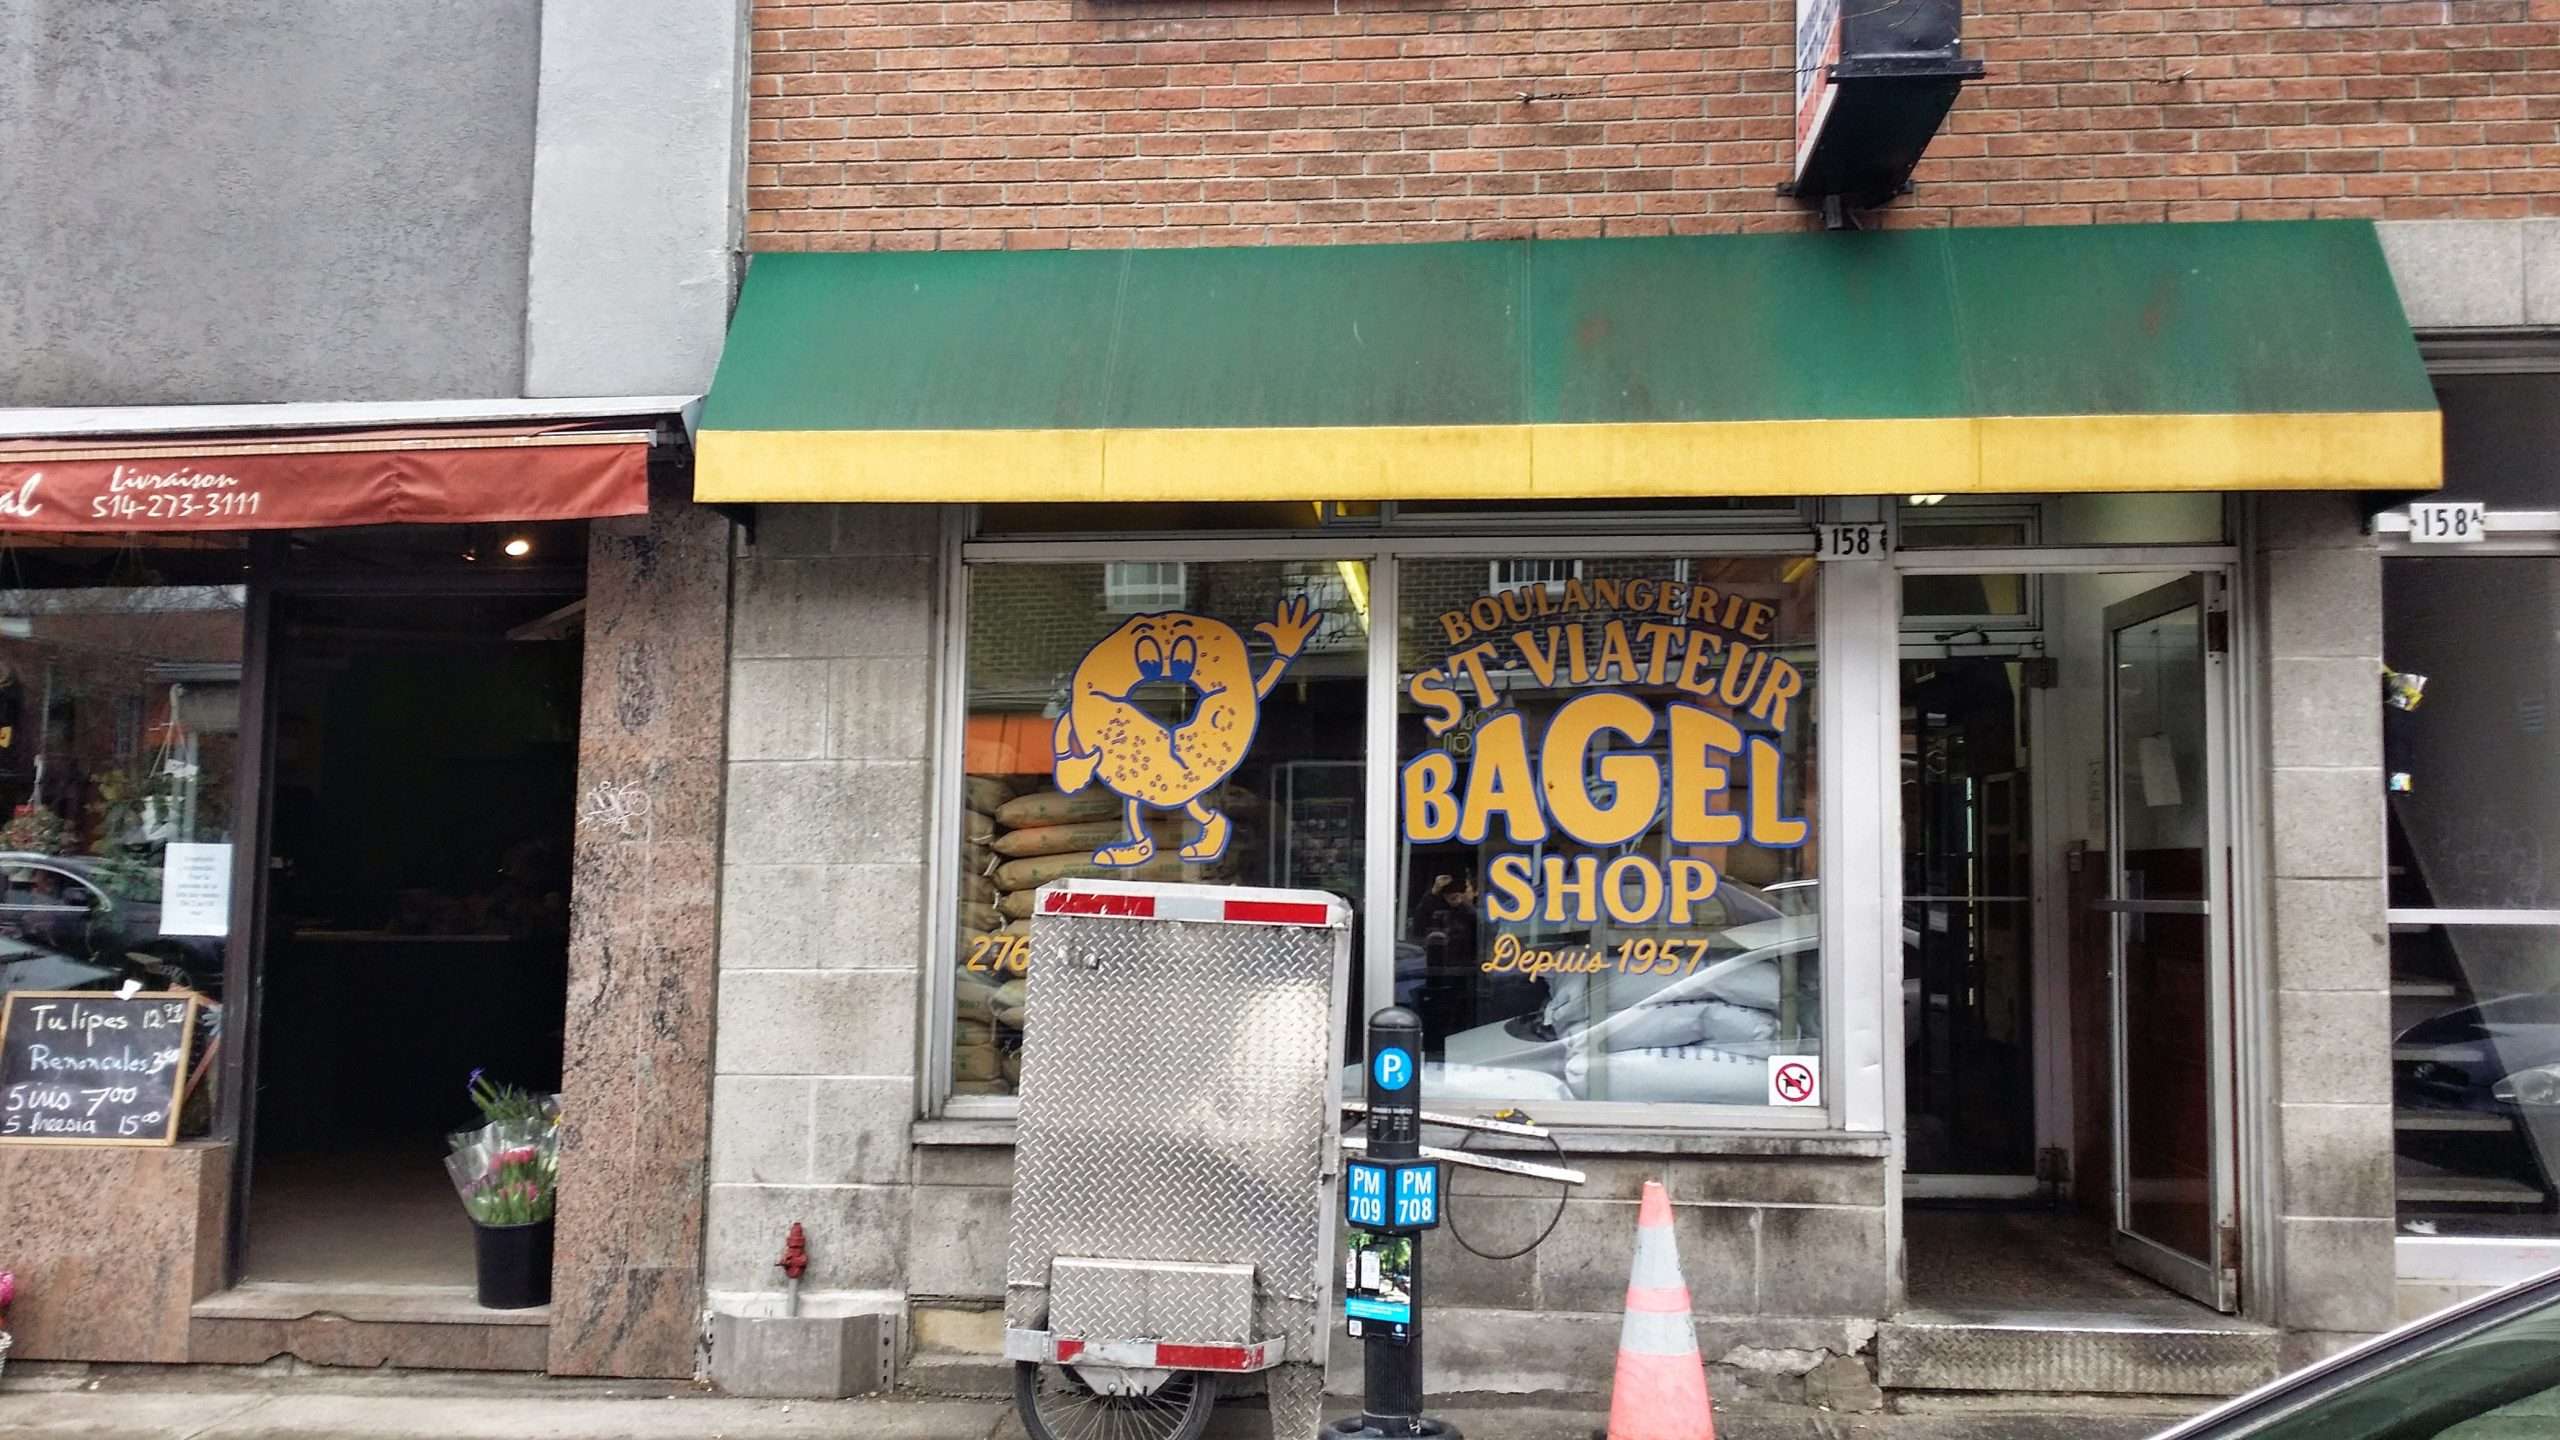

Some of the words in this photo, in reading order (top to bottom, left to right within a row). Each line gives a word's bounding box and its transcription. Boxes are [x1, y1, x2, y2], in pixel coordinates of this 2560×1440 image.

[109, 465, 239, 492] Livraison
[91, 491, 261, 520] 514-273-3111
[1832, 526, 1870, 555] 158
[1439, 577, 1776, 645] BOULANGERIE
[1402, 692, 1809, 847] BAGEL
[1487, 854, 1718, 925] SHOP
[1480, 933, 1611, 983] Depuis
[1617, 938, 1710, 977] 1957
[30, 1003, 129, 1047] Tulipes
[1353, 1167, 1380, 1195] PM
[1402, 1170, 1432, 1195] PM
[1350, 1196, 1381, 1222] 709
[1399, 1197, 1432, 1223] 708
